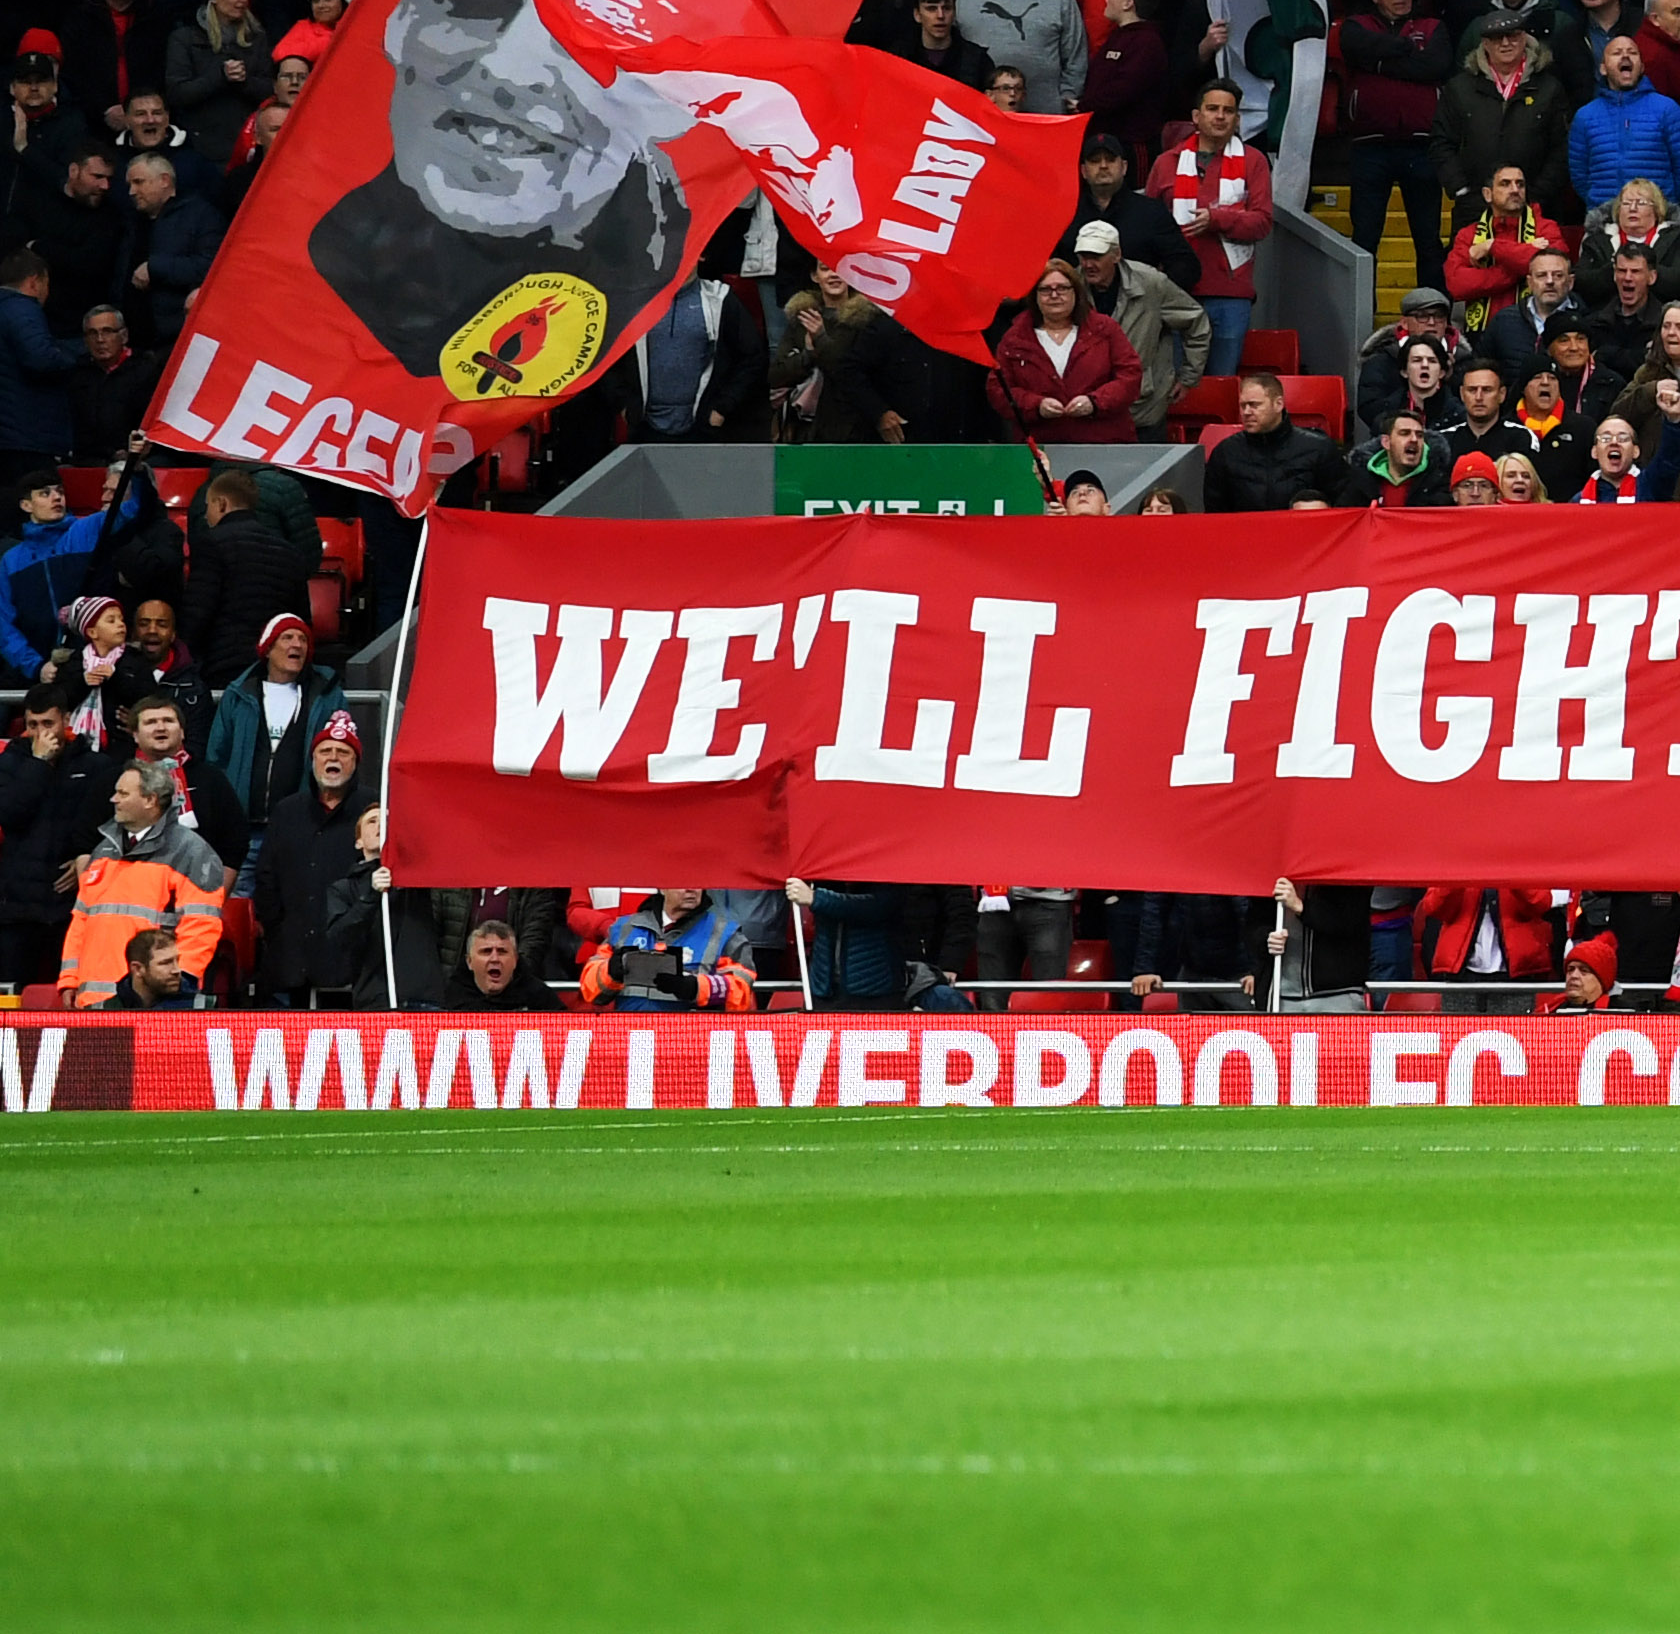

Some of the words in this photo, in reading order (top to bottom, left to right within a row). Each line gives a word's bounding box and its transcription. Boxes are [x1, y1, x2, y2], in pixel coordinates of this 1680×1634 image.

[449, 279, 564, 352] HILLSBOROUGH
[538, 322, 598, 397] CAMPAIGN
[456, 360, 478, 377] FOR
[483, 589, 1090, 797] WE'LL
